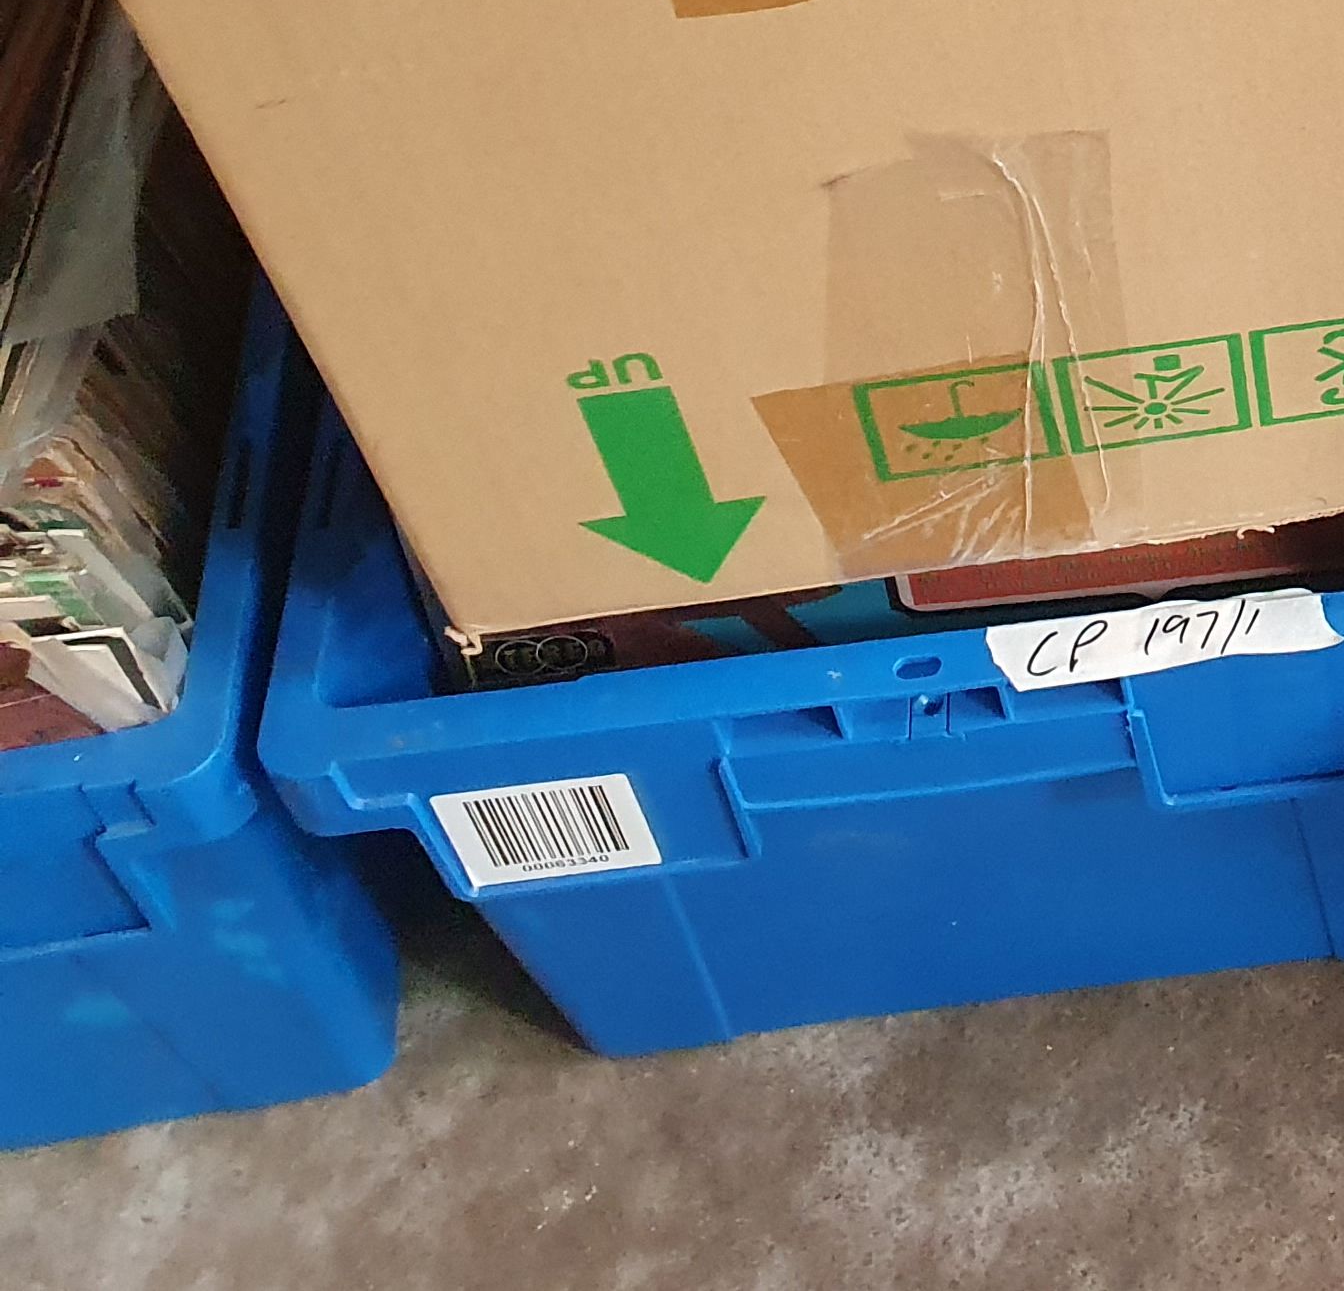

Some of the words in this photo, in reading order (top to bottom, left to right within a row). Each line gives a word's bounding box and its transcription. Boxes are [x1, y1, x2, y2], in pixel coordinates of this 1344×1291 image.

[566, 352, 664, 389] UP
[1026, 620, 1108, 677] CP
[1143, 598, 1261, 656] 197/1
